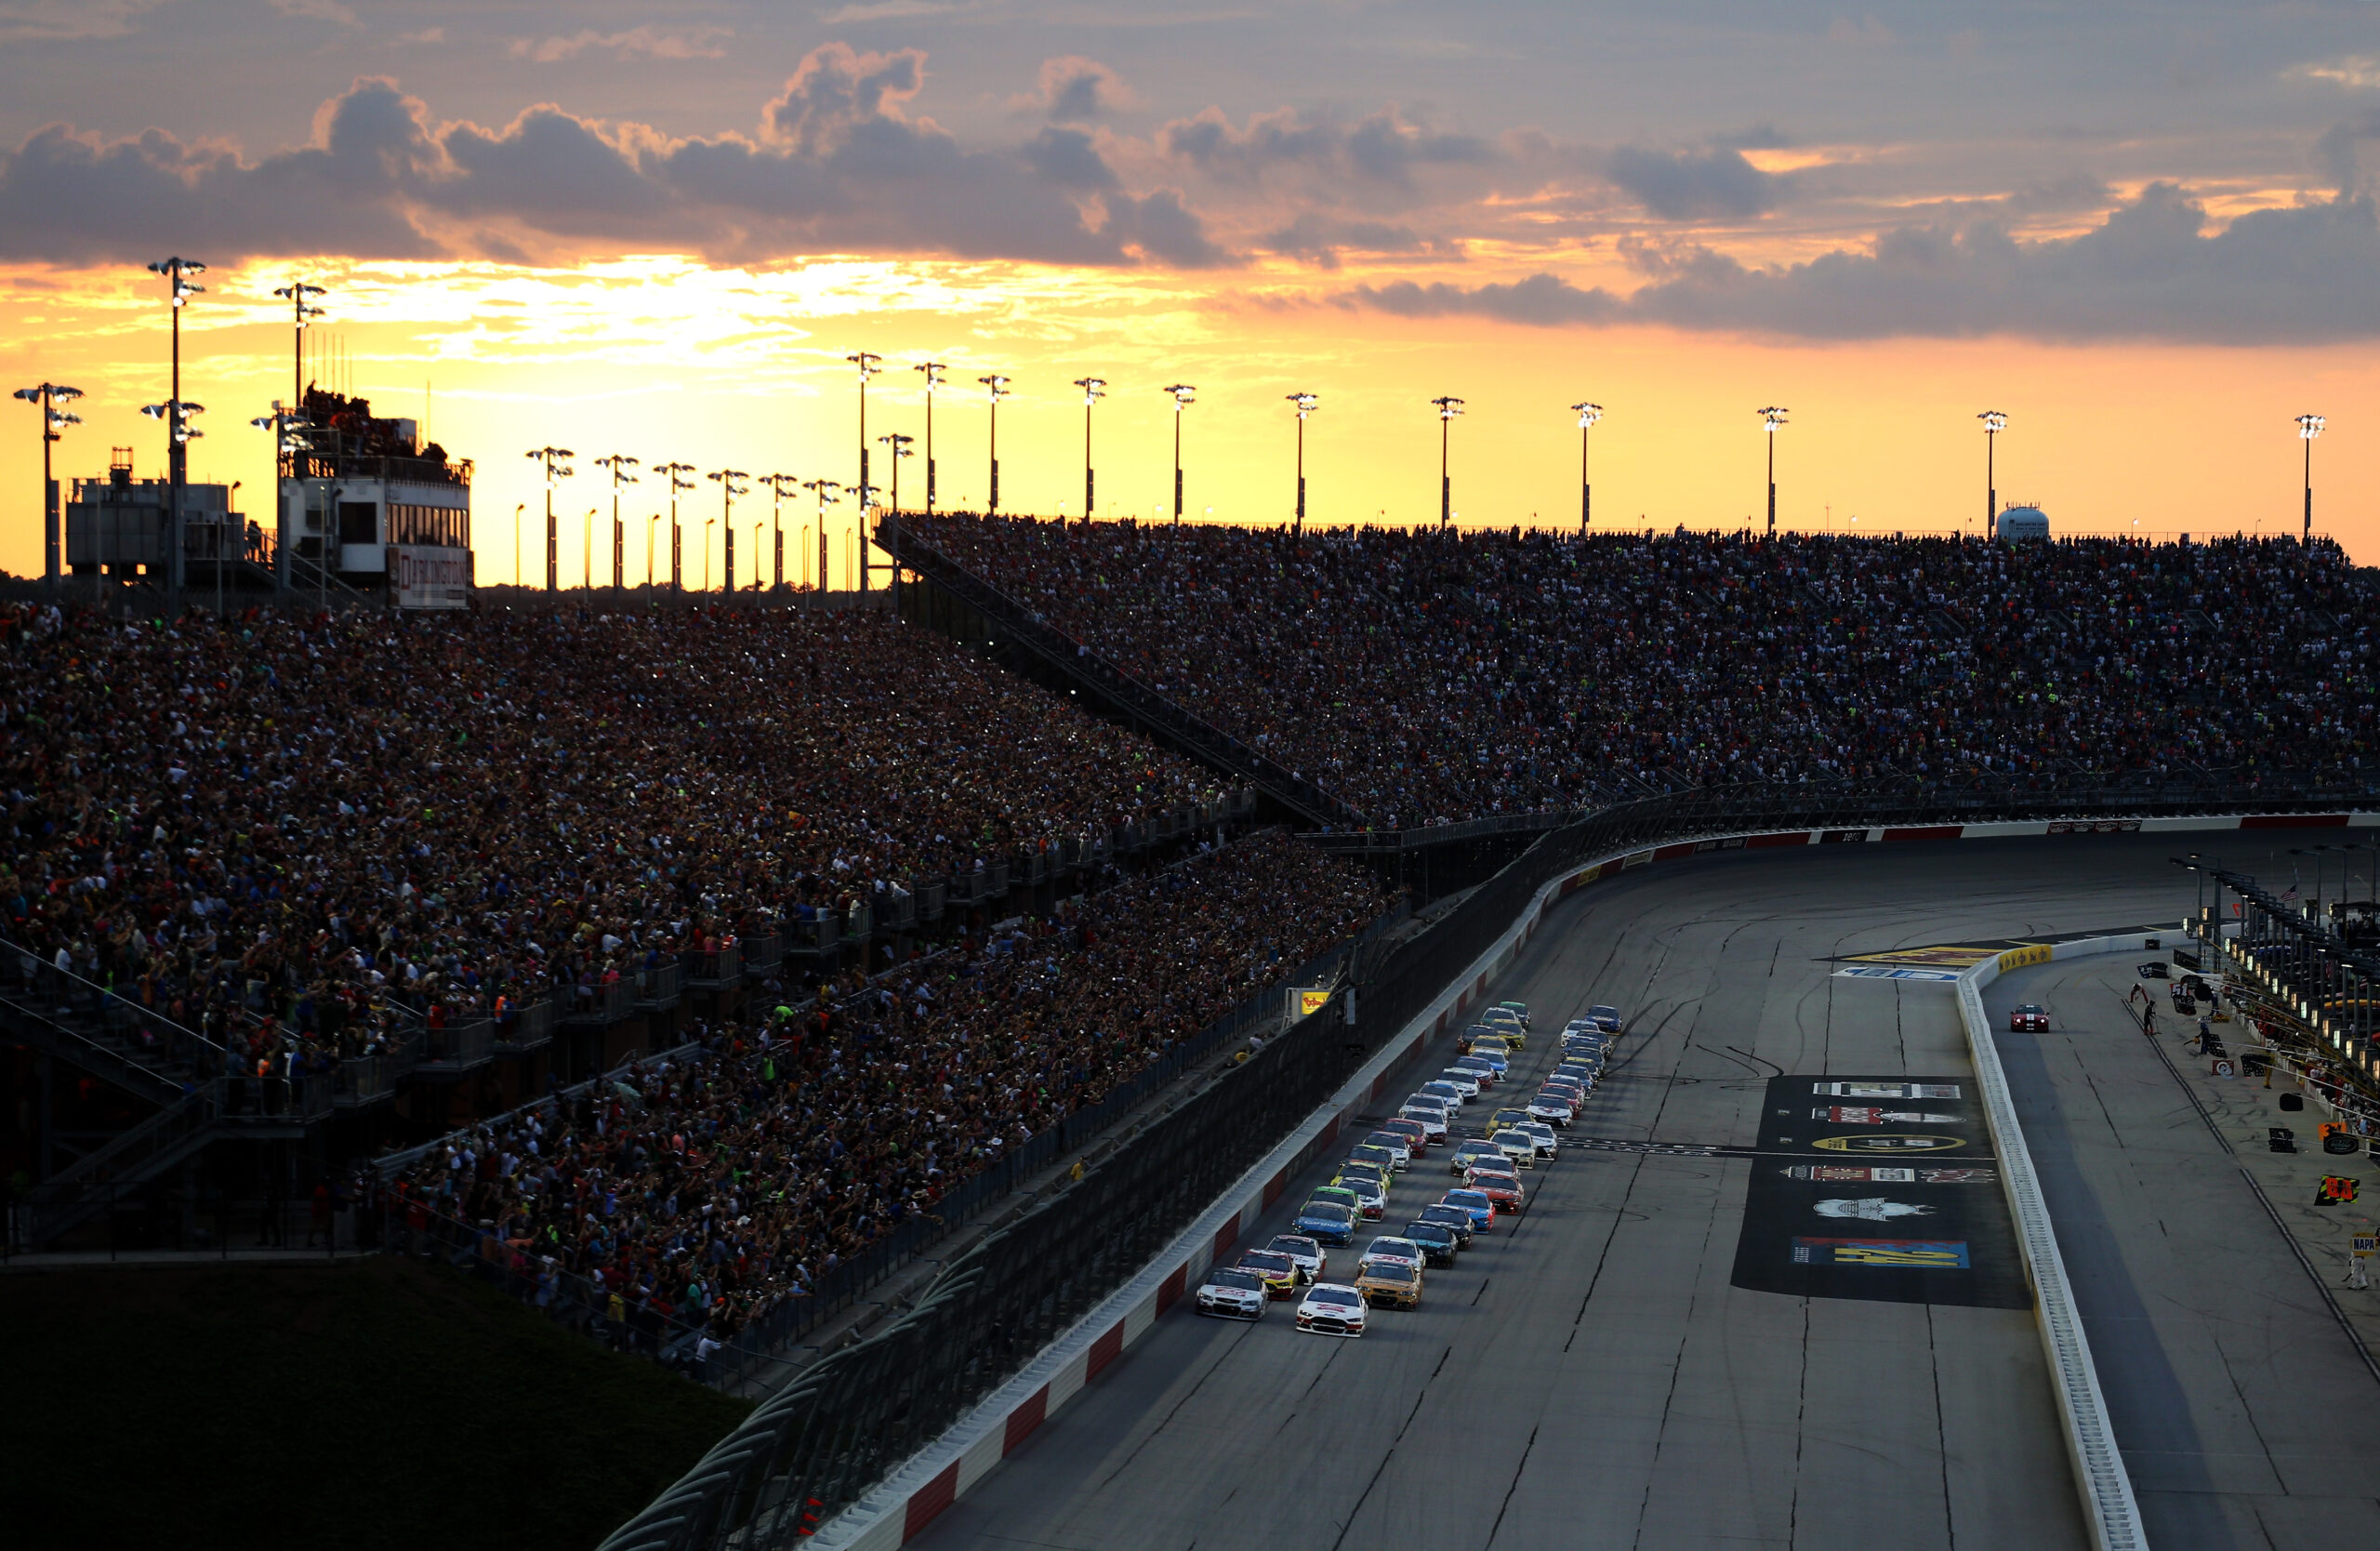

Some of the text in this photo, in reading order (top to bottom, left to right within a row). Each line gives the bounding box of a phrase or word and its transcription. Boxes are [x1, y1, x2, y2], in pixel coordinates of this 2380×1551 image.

[401, 555, 466, 590] DARLINGTON
[2172, 983, 2188, 996] 51
[2354, 1239, 2375, 1251] NAPA
